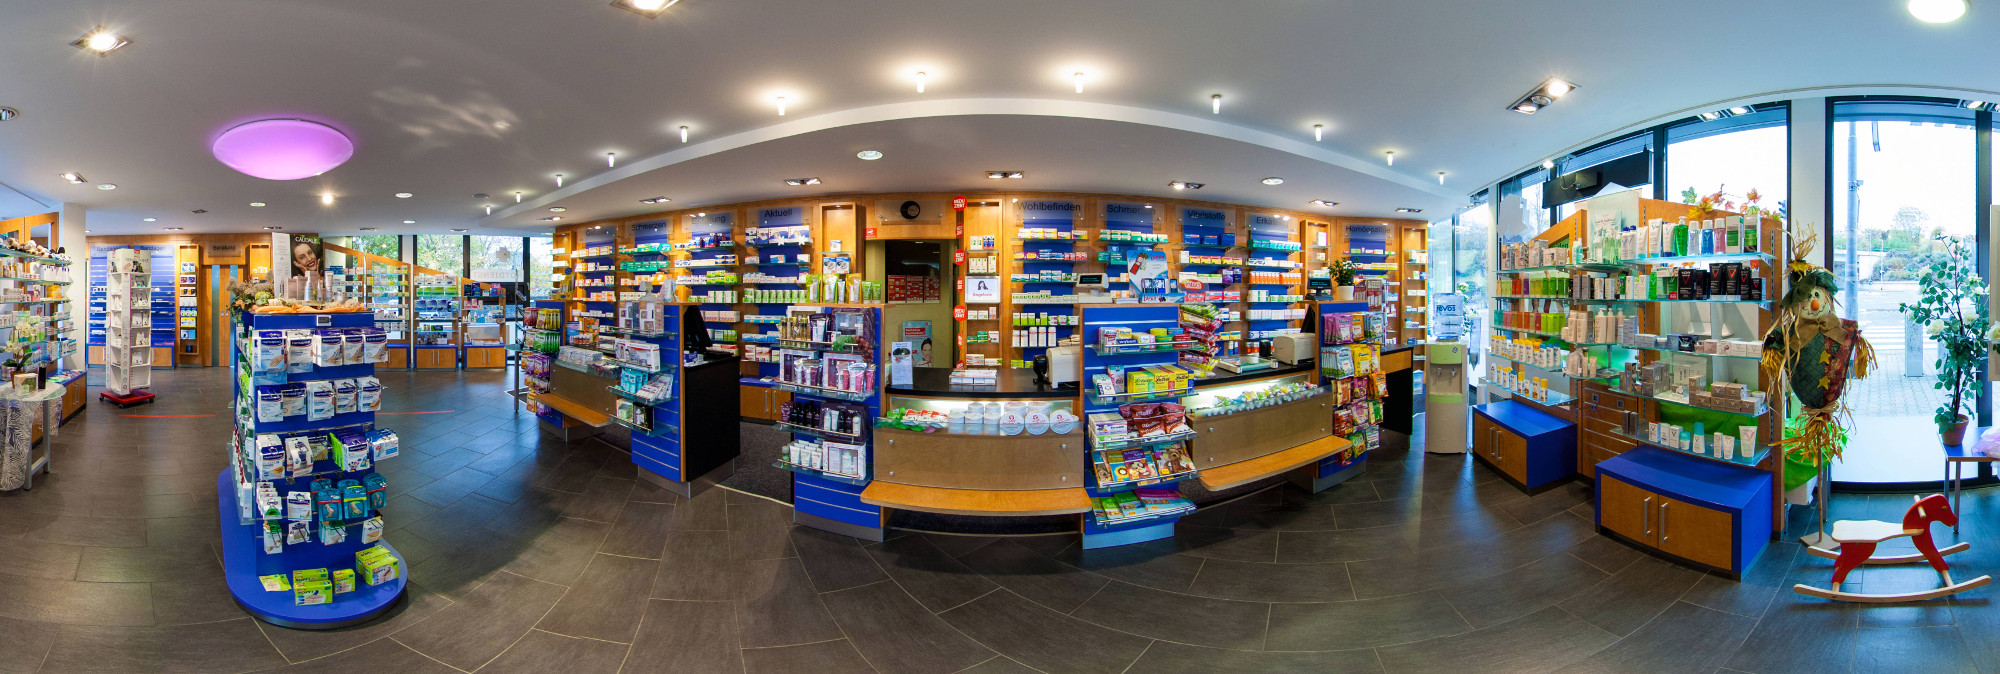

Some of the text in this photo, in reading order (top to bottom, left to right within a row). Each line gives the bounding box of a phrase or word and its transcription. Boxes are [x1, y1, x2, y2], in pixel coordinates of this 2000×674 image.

[1017, 202, 1080, 212] Wohlbefinden
[764, 209, 792, 218] Aktuell
[1188, 210, 1226, 220] Vitalstoffe
[632, 221, 666, 231] Schmerzen
[1346, 226, 1391, 234] Homöopathie
